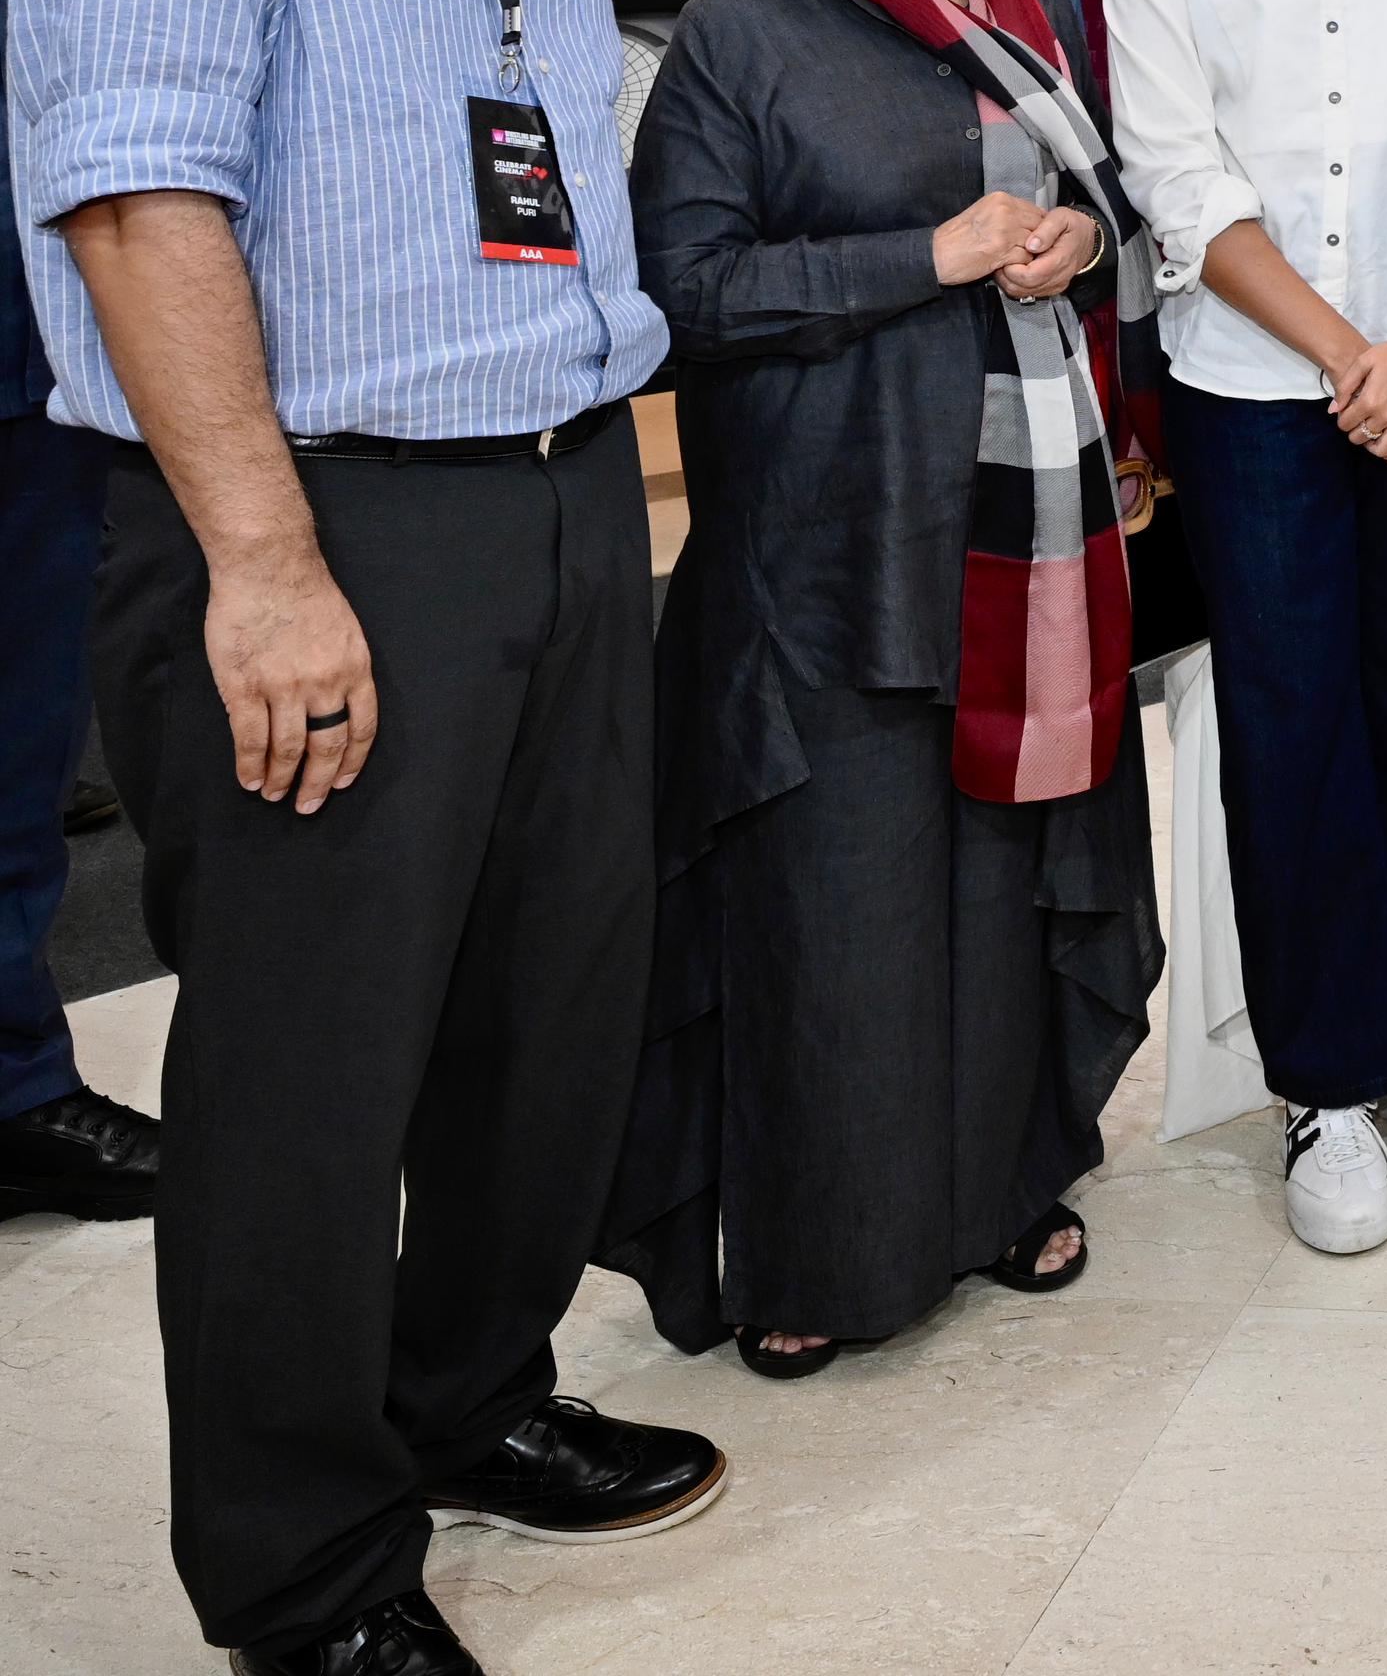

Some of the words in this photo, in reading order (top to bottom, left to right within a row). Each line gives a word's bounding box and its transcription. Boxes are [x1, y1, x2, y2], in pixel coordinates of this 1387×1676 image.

[510, 195, 541, 208] RAHUL
[516, 206, 537, 217] PURI
[519, 248, 544, 260] AAA
